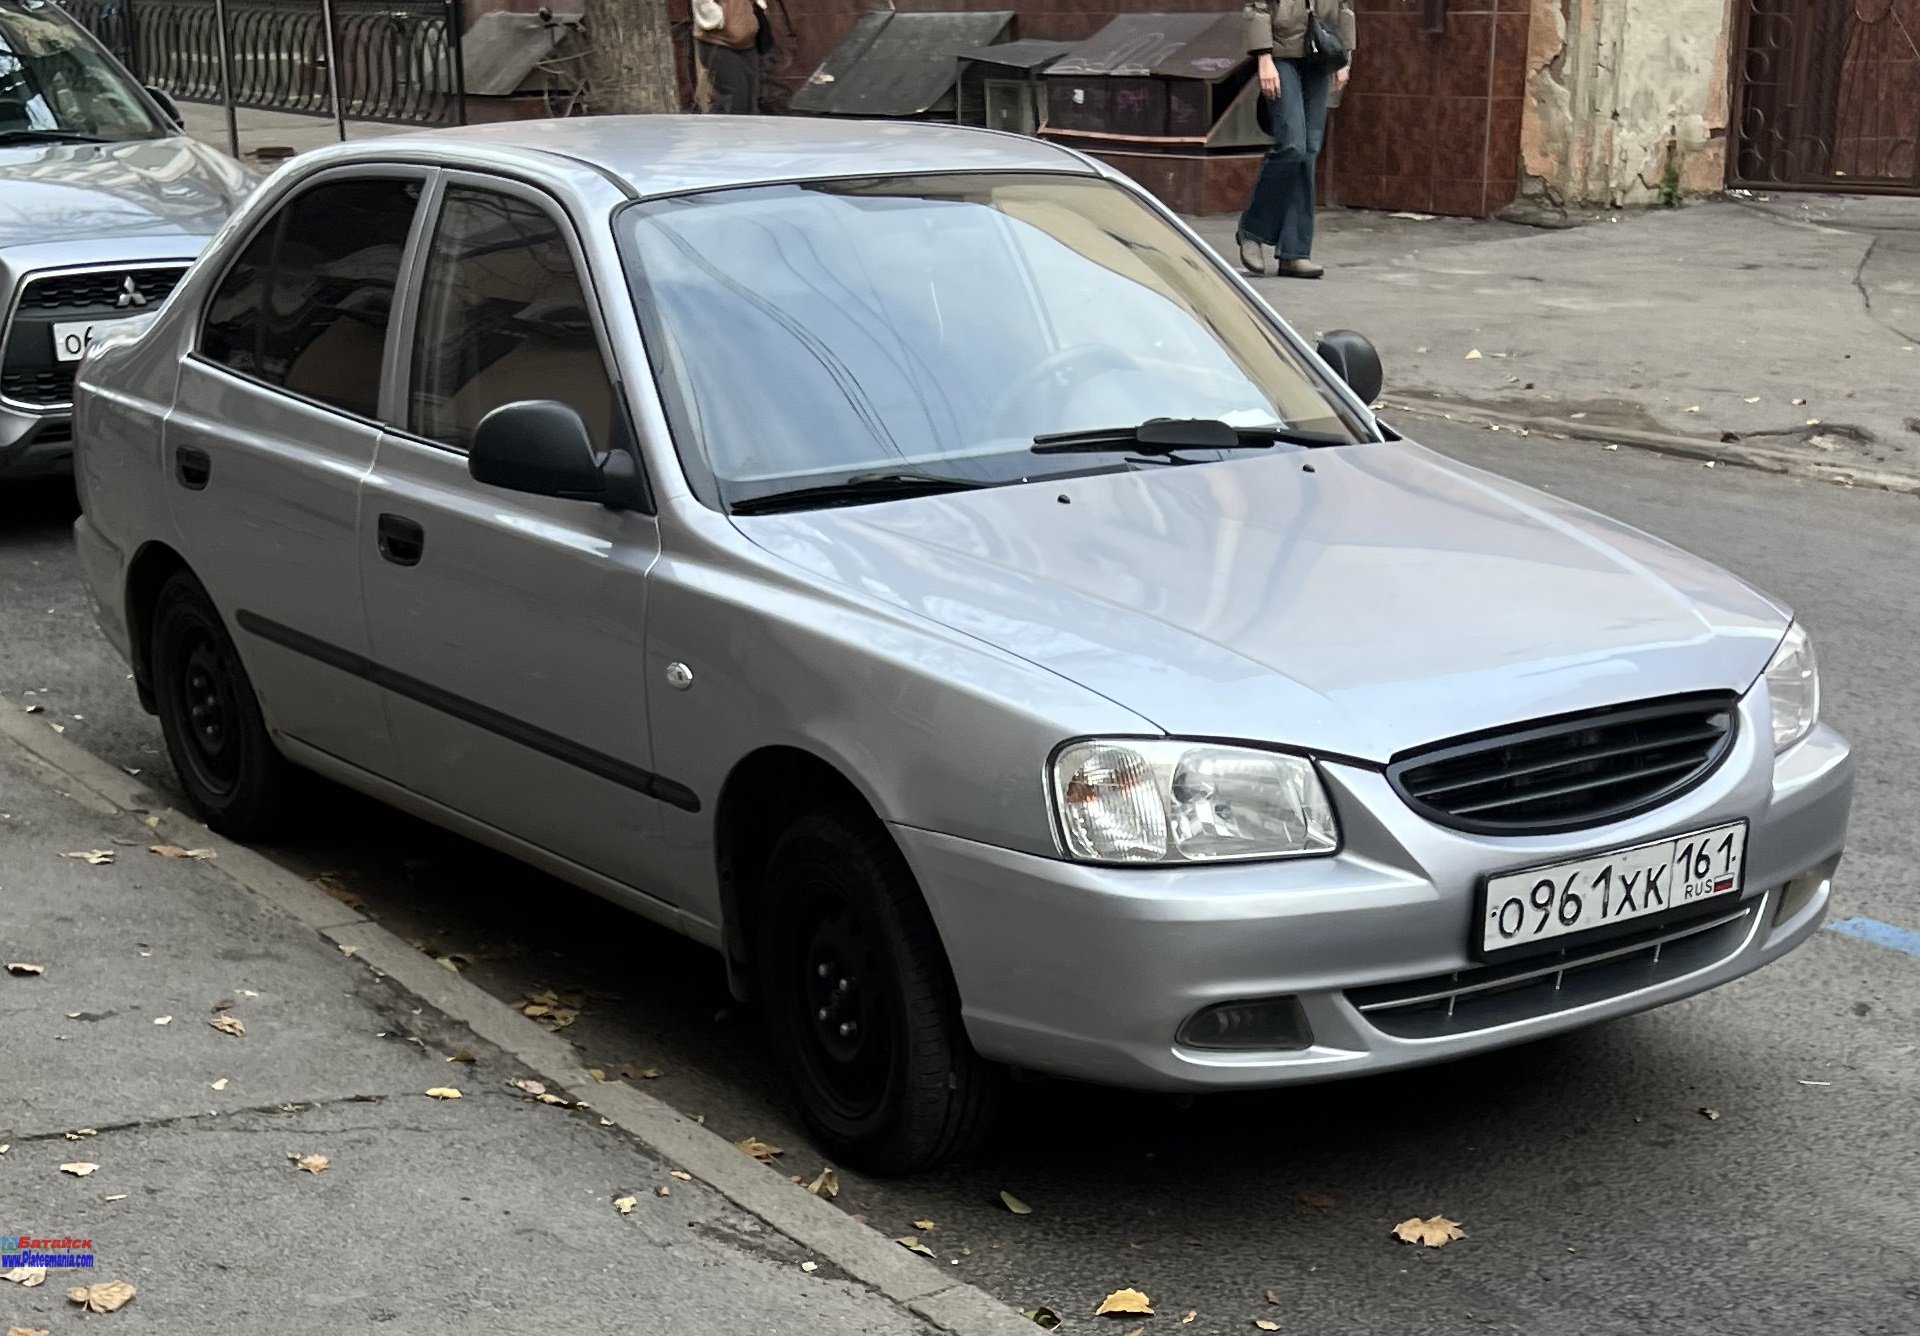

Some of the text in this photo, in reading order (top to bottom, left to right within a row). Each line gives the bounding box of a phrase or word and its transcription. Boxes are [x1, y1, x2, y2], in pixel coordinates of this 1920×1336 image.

[1499, 832, 1734, 938] О961ХК 161
[1685, 880, 1713, 899] RUS
